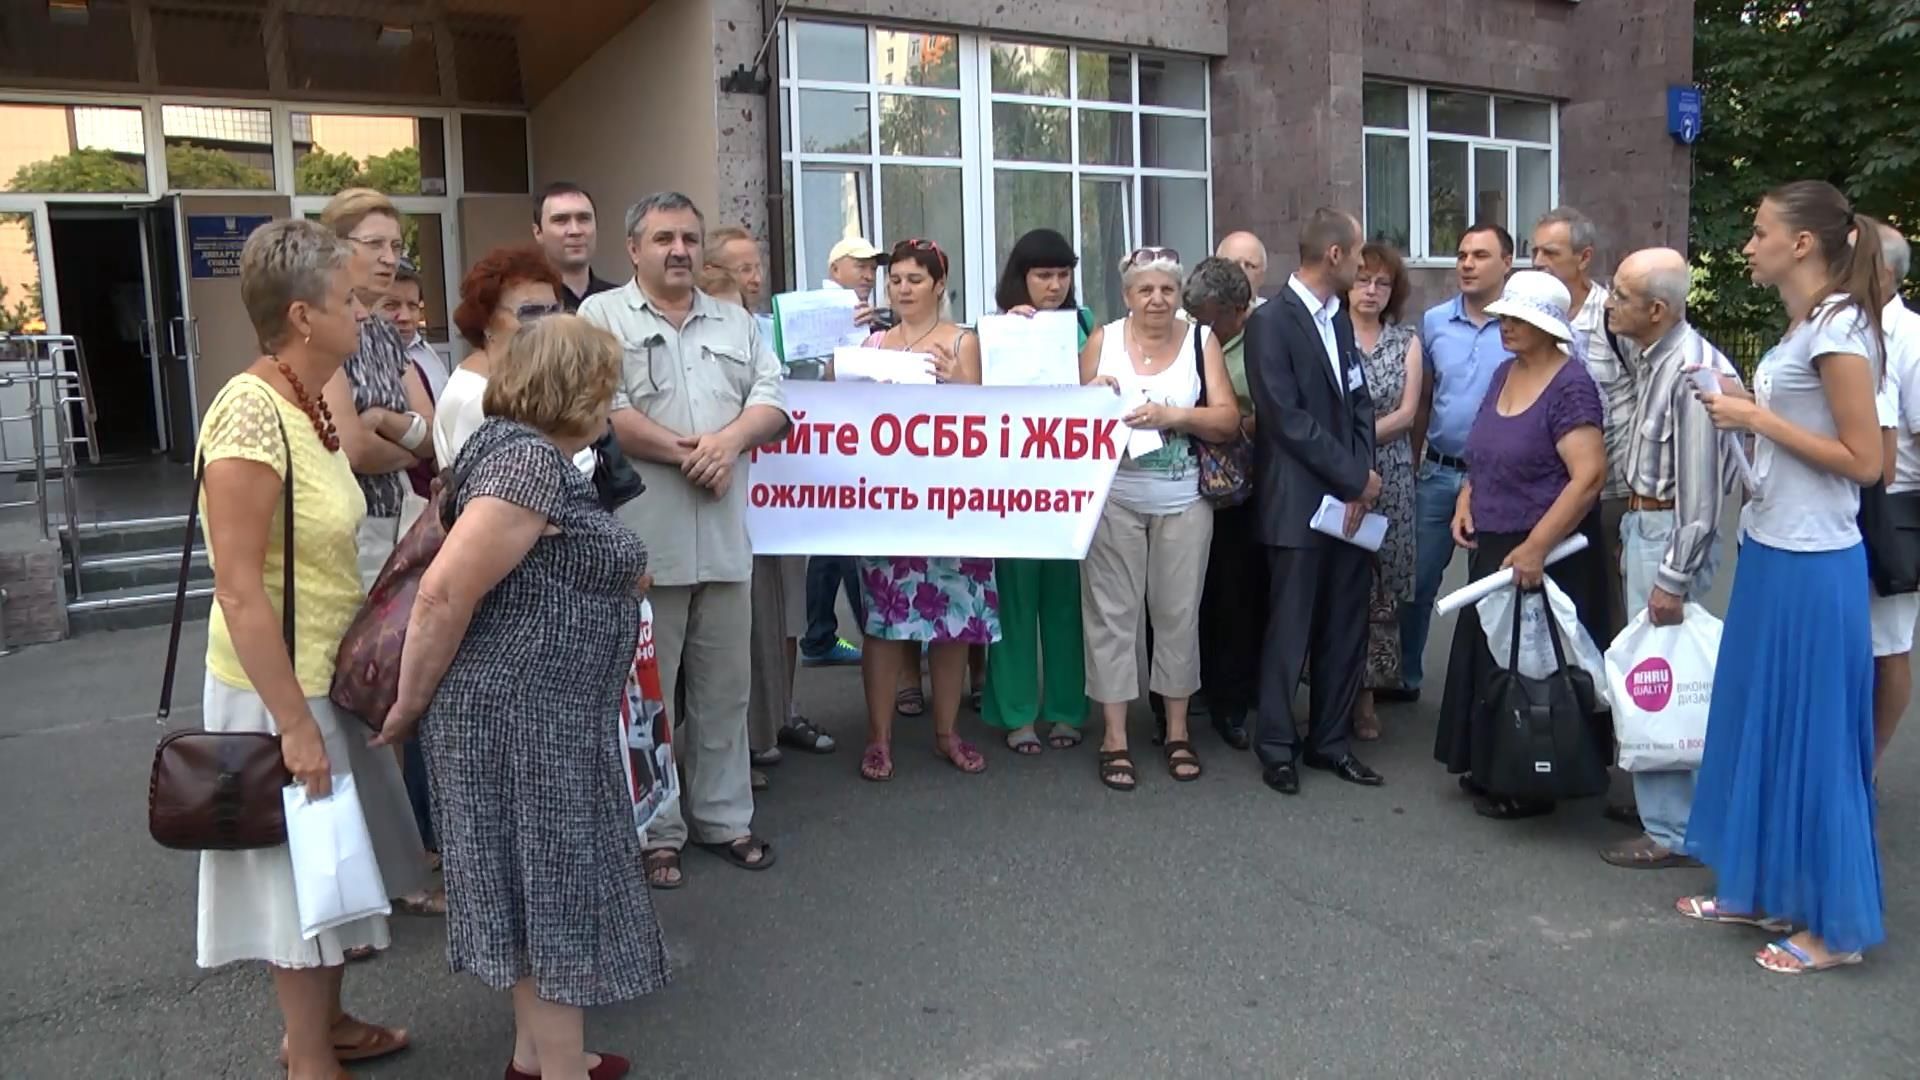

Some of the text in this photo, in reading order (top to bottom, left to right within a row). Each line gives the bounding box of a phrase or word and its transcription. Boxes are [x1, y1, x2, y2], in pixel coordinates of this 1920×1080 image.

[870, 413, 988, 458] ОСББ
[1020, 416, 1120, 460] ЖБК
[748, 477, 919, 510] ожливість
[1633, 683, 1669, 697] QUALITY
